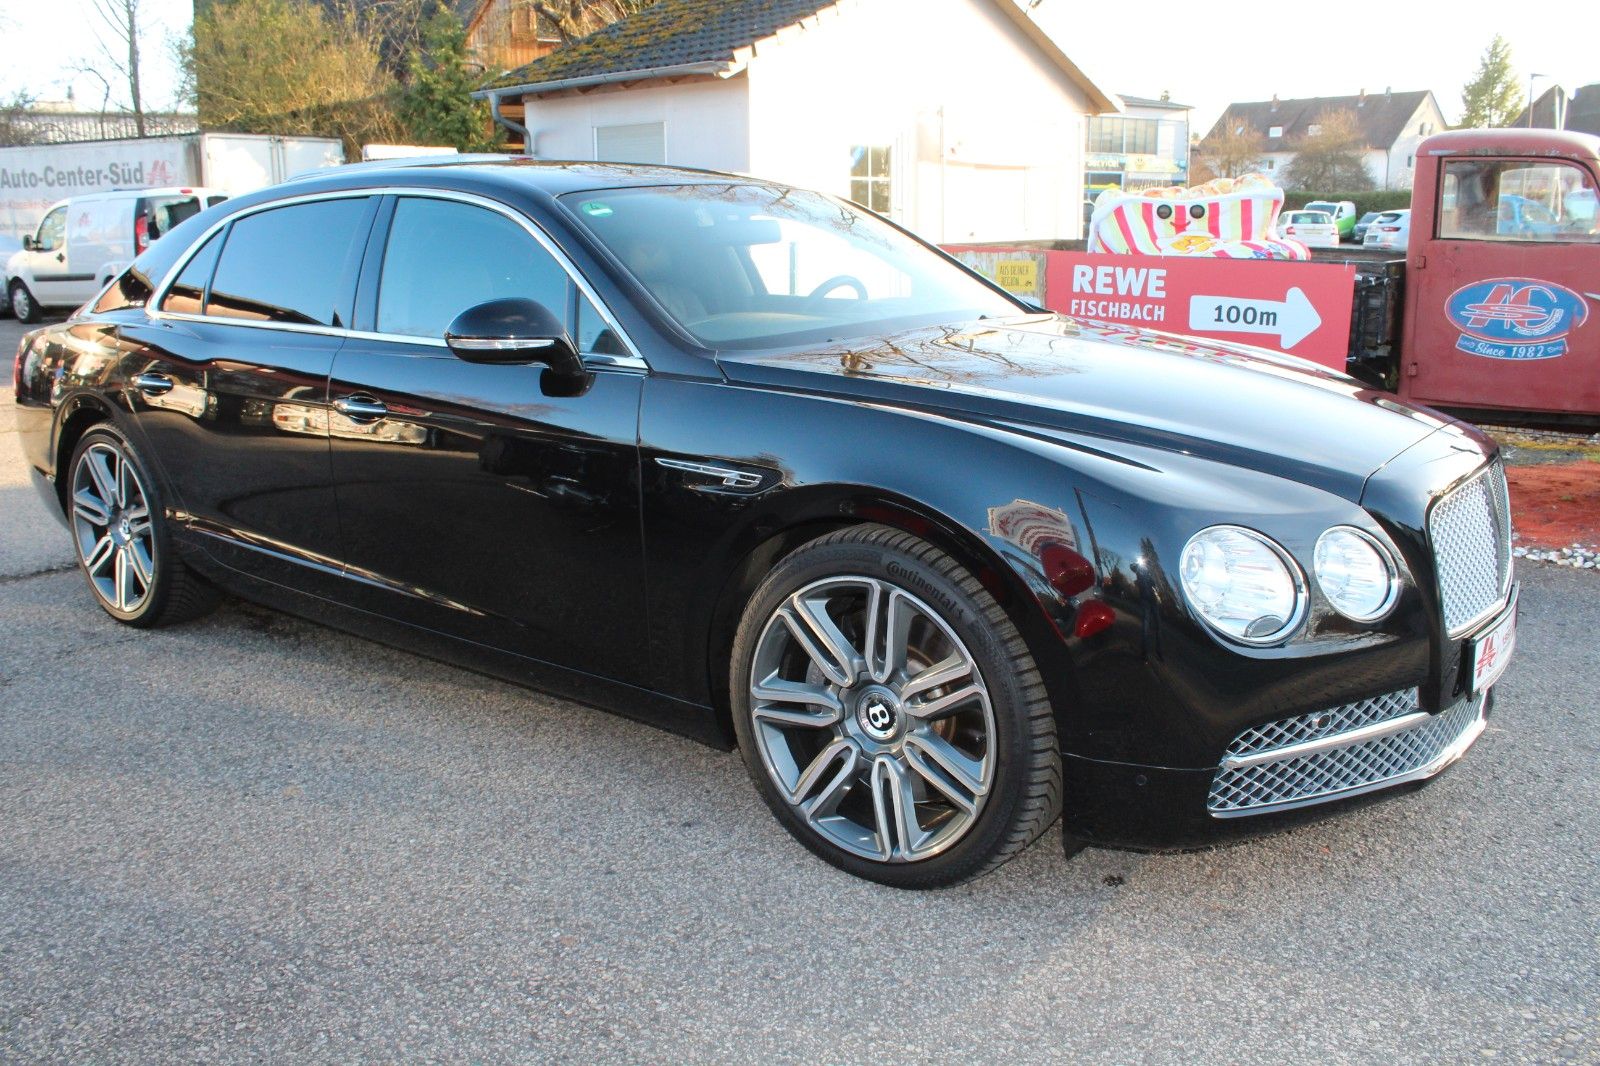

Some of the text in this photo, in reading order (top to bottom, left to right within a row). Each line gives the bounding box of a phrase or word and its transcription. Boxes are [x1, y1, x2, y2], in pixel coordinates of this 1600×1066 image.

[1072, 264, 1167, 298] REWE
[1071, 299, 1165, 321] FISCHBACH
[1213, 304, 1278, 327] 100m
[1475, 342, 1545, 358] Since 1982
[886, 561, 955, 611] Continental
